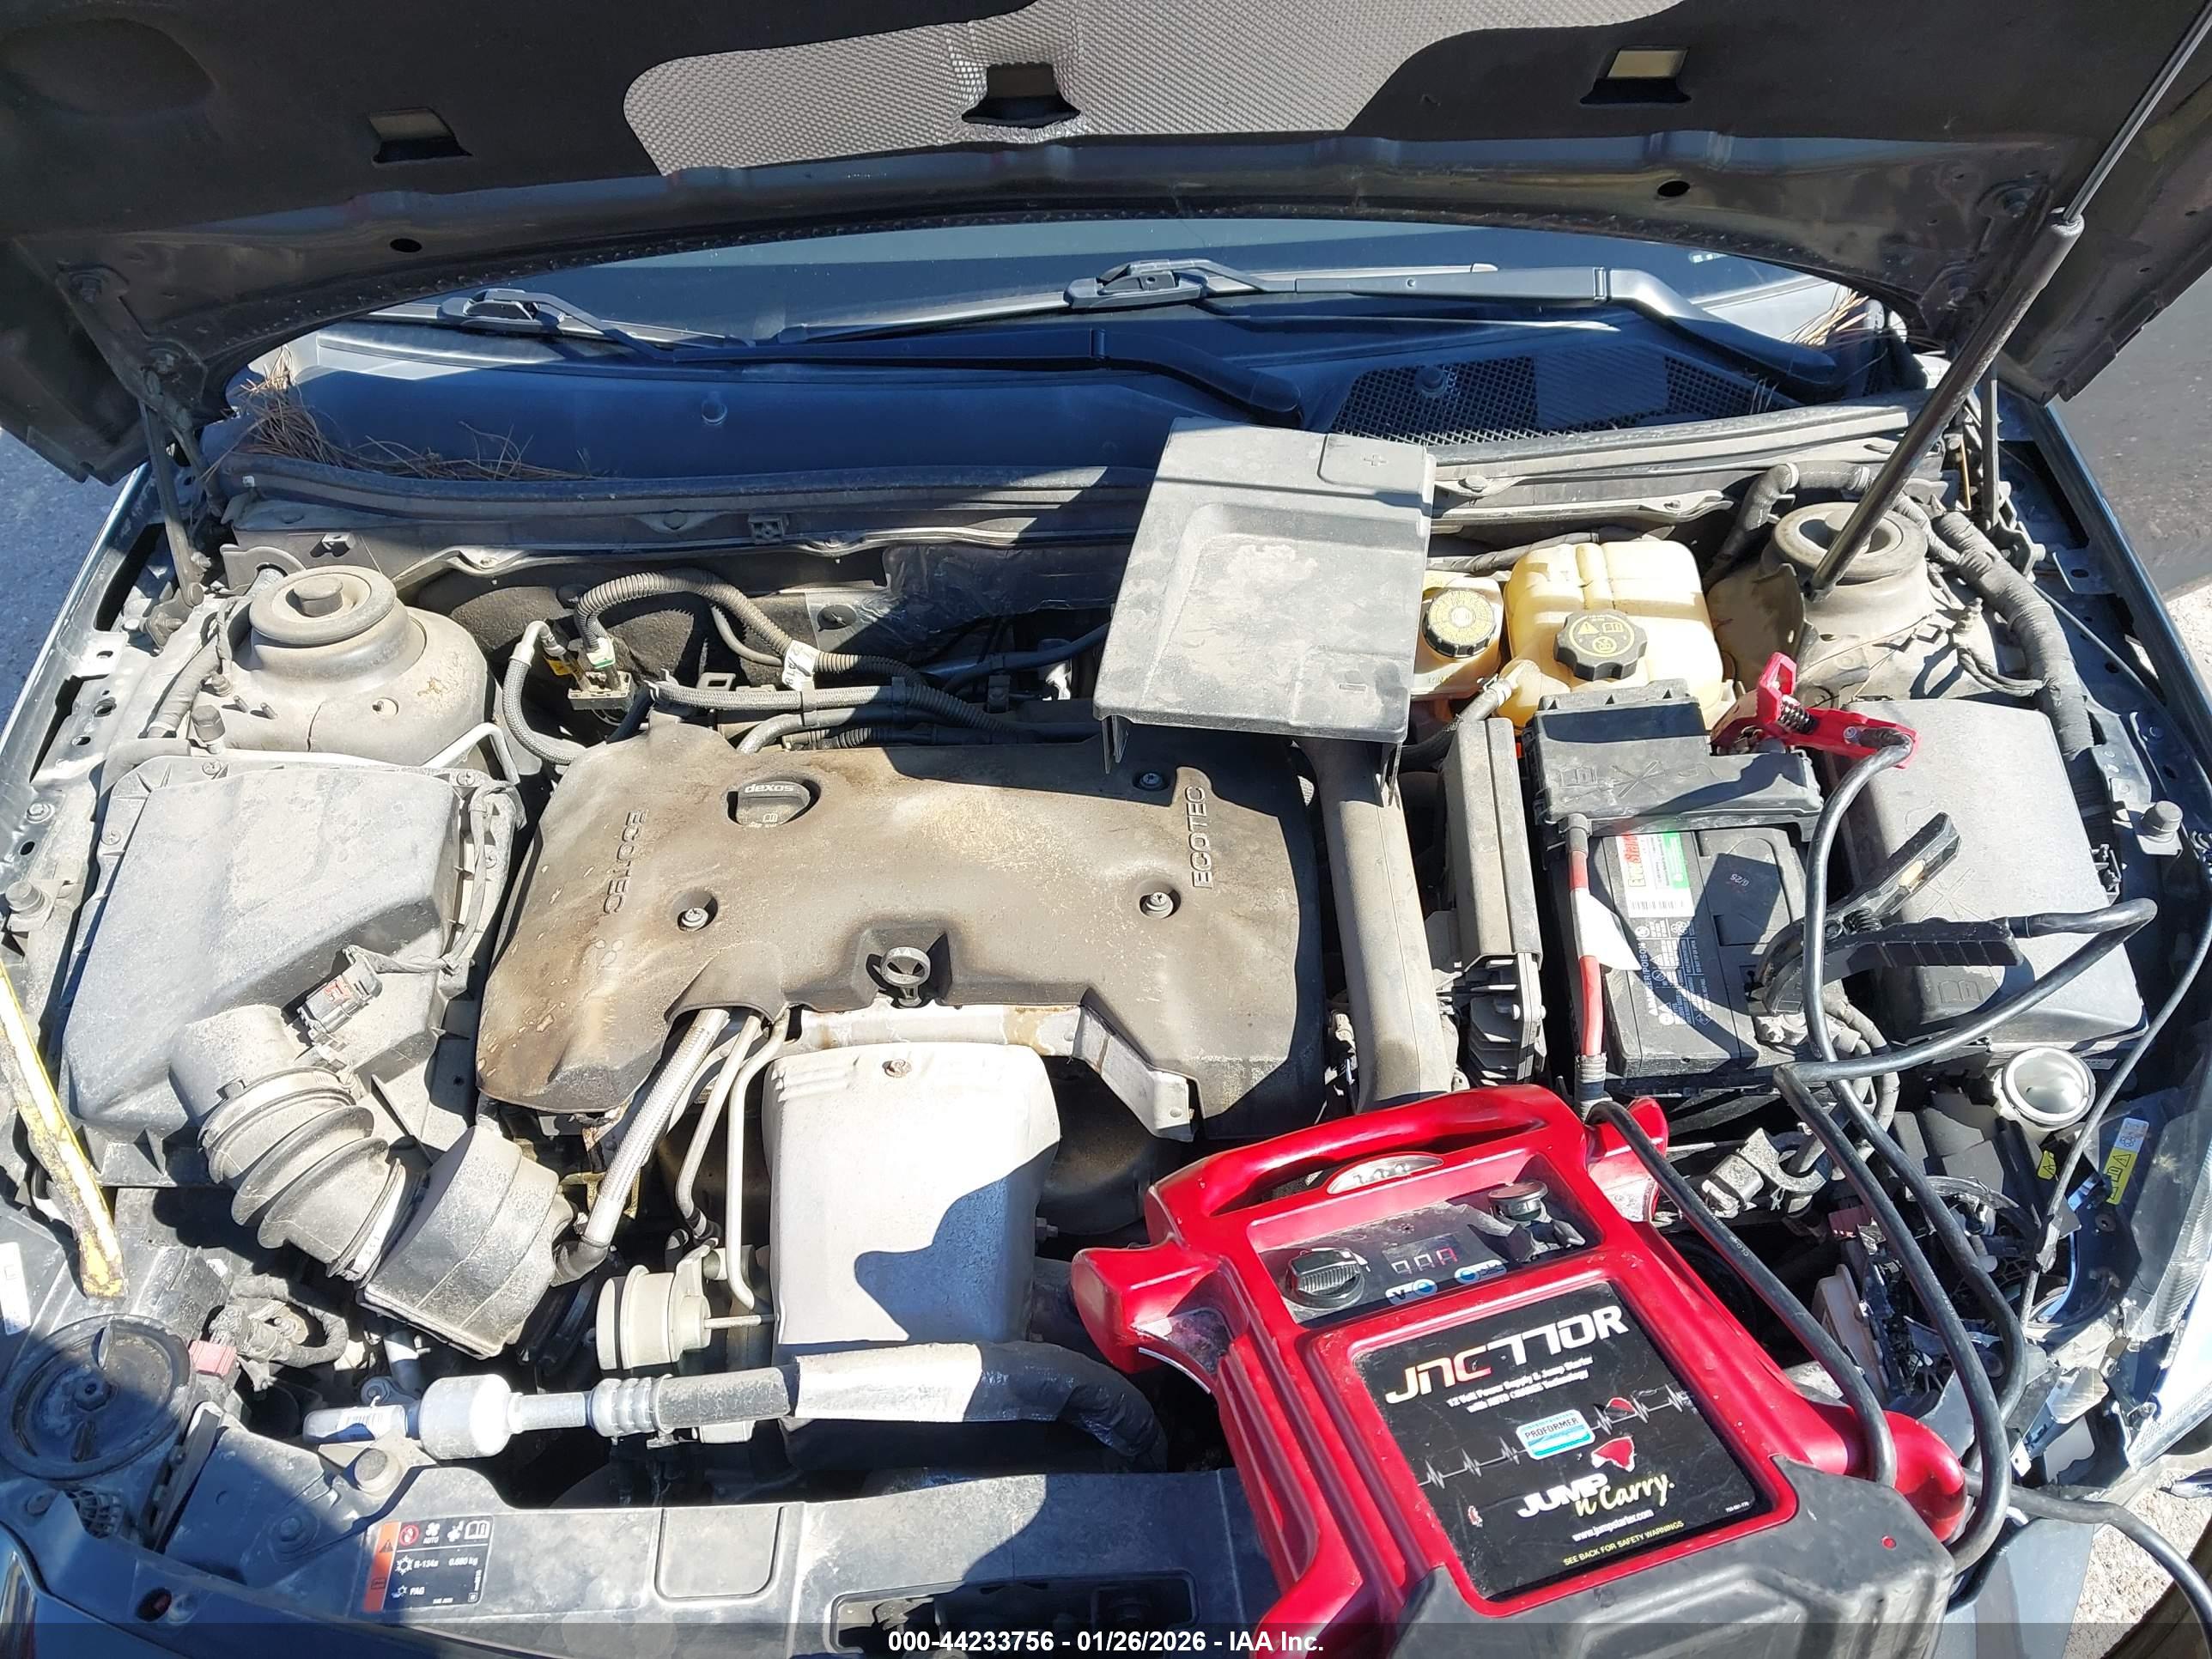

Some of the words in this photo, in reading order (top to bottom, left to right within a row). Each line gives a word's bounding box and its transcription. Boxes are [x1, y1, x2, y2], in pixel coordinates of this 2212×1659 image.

[744, 783, 795, 793] dexos
[1184, 786, 1213, 889] ECOTEC
[603, 811, 647, 915] ECOTEC
[1524, 1417, 1580, 1440] PROFORMER
[1516, 1473, 1608, 1518] JUMP
[1563, 1554, 1579, 1566] SEE
[1578, 1547, 1601, 1561] BACK
[1600, 1541, 1618, 1555] FOR
[1617, 1533, 1645, 1548] SAFETY
[1644, 1520, 1686, 1540] WARNINGS
